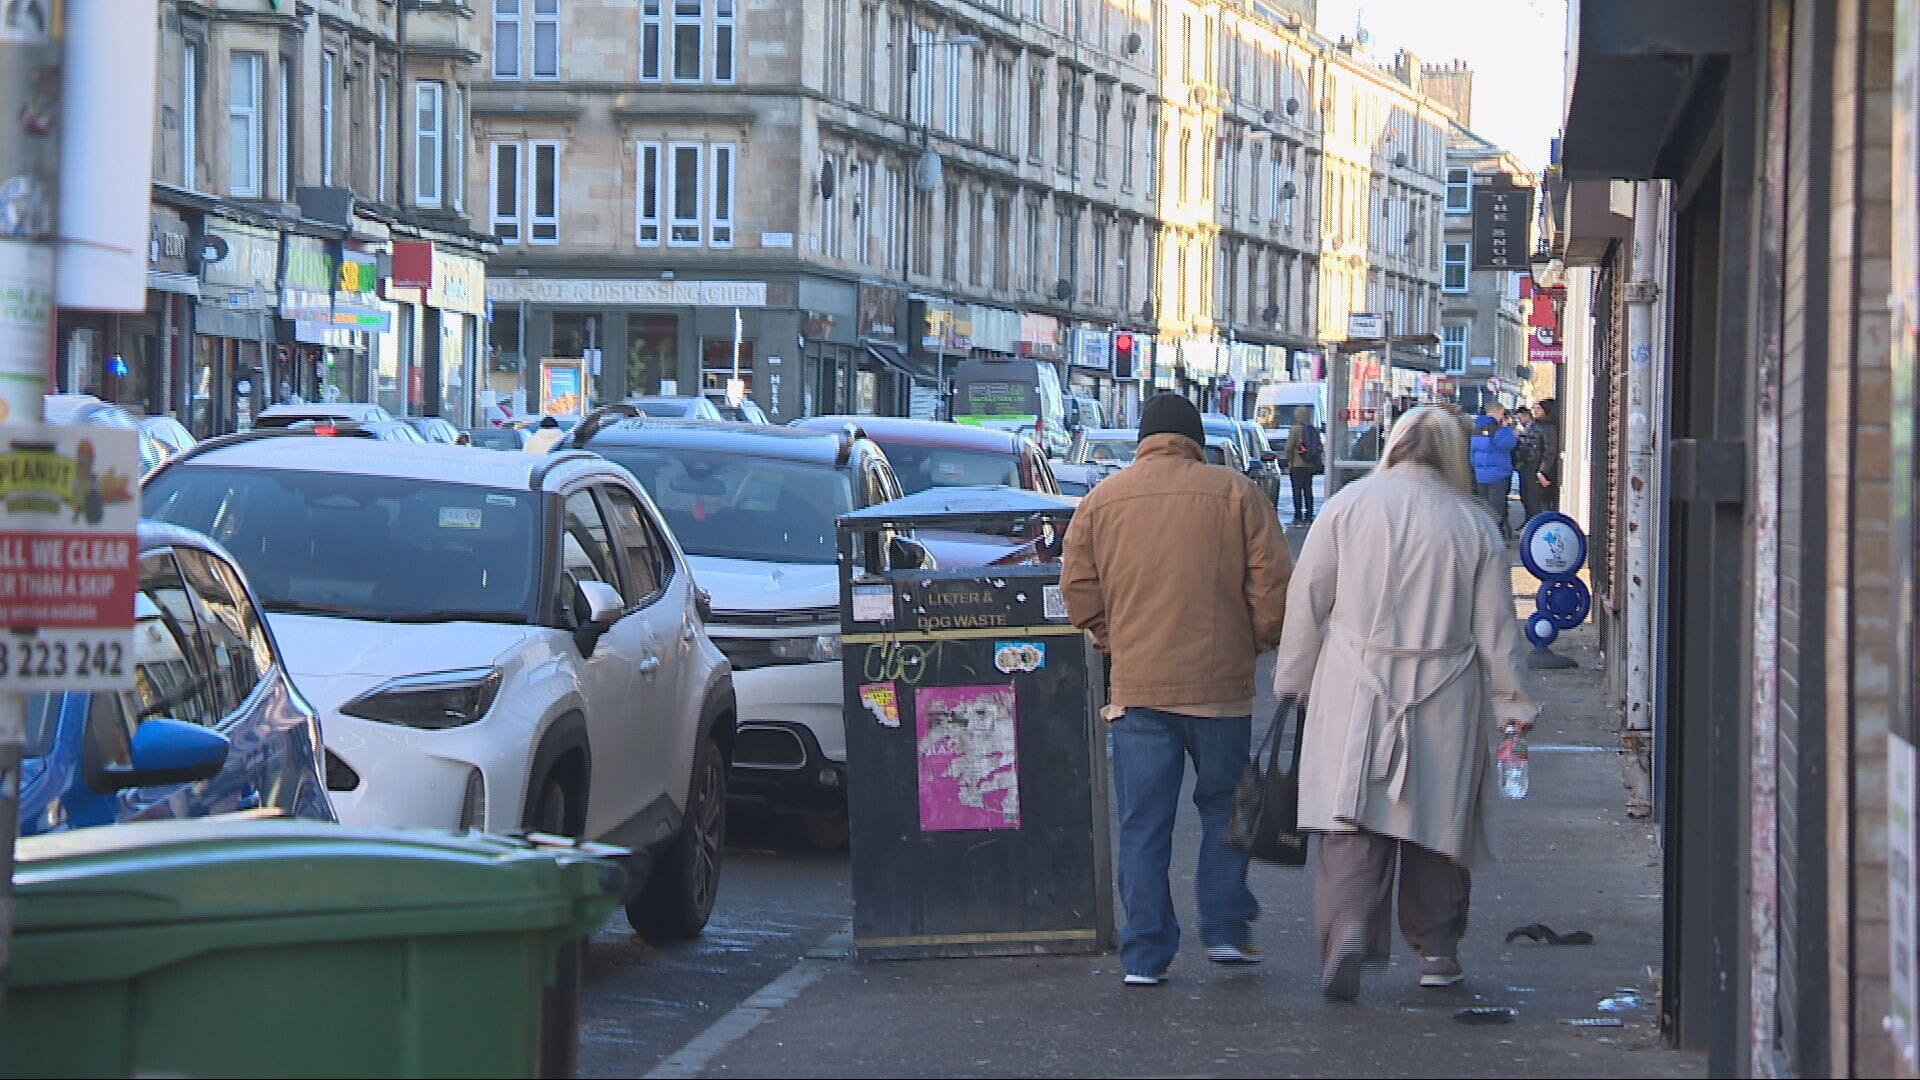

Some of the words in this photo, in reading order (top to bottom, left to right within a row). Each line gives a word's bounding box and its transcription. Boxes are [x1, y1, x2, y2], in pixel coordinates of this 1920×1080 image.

[591, 283, 698, 303] DISPENSING
[31, 539, 64, 569] WE
[67, 539, 130, 570] CLEAR
[19, 573, 64, 598] THAN
[79, 574, 115, 598] SKIP
[928, 592, 980, 606] LITTER
[917, 616, 952, 629] DOG
[953, 614, 1007, 627] WASTE
[18, 641, 68, 677] 223
[77, 640, 123, 677] 242
